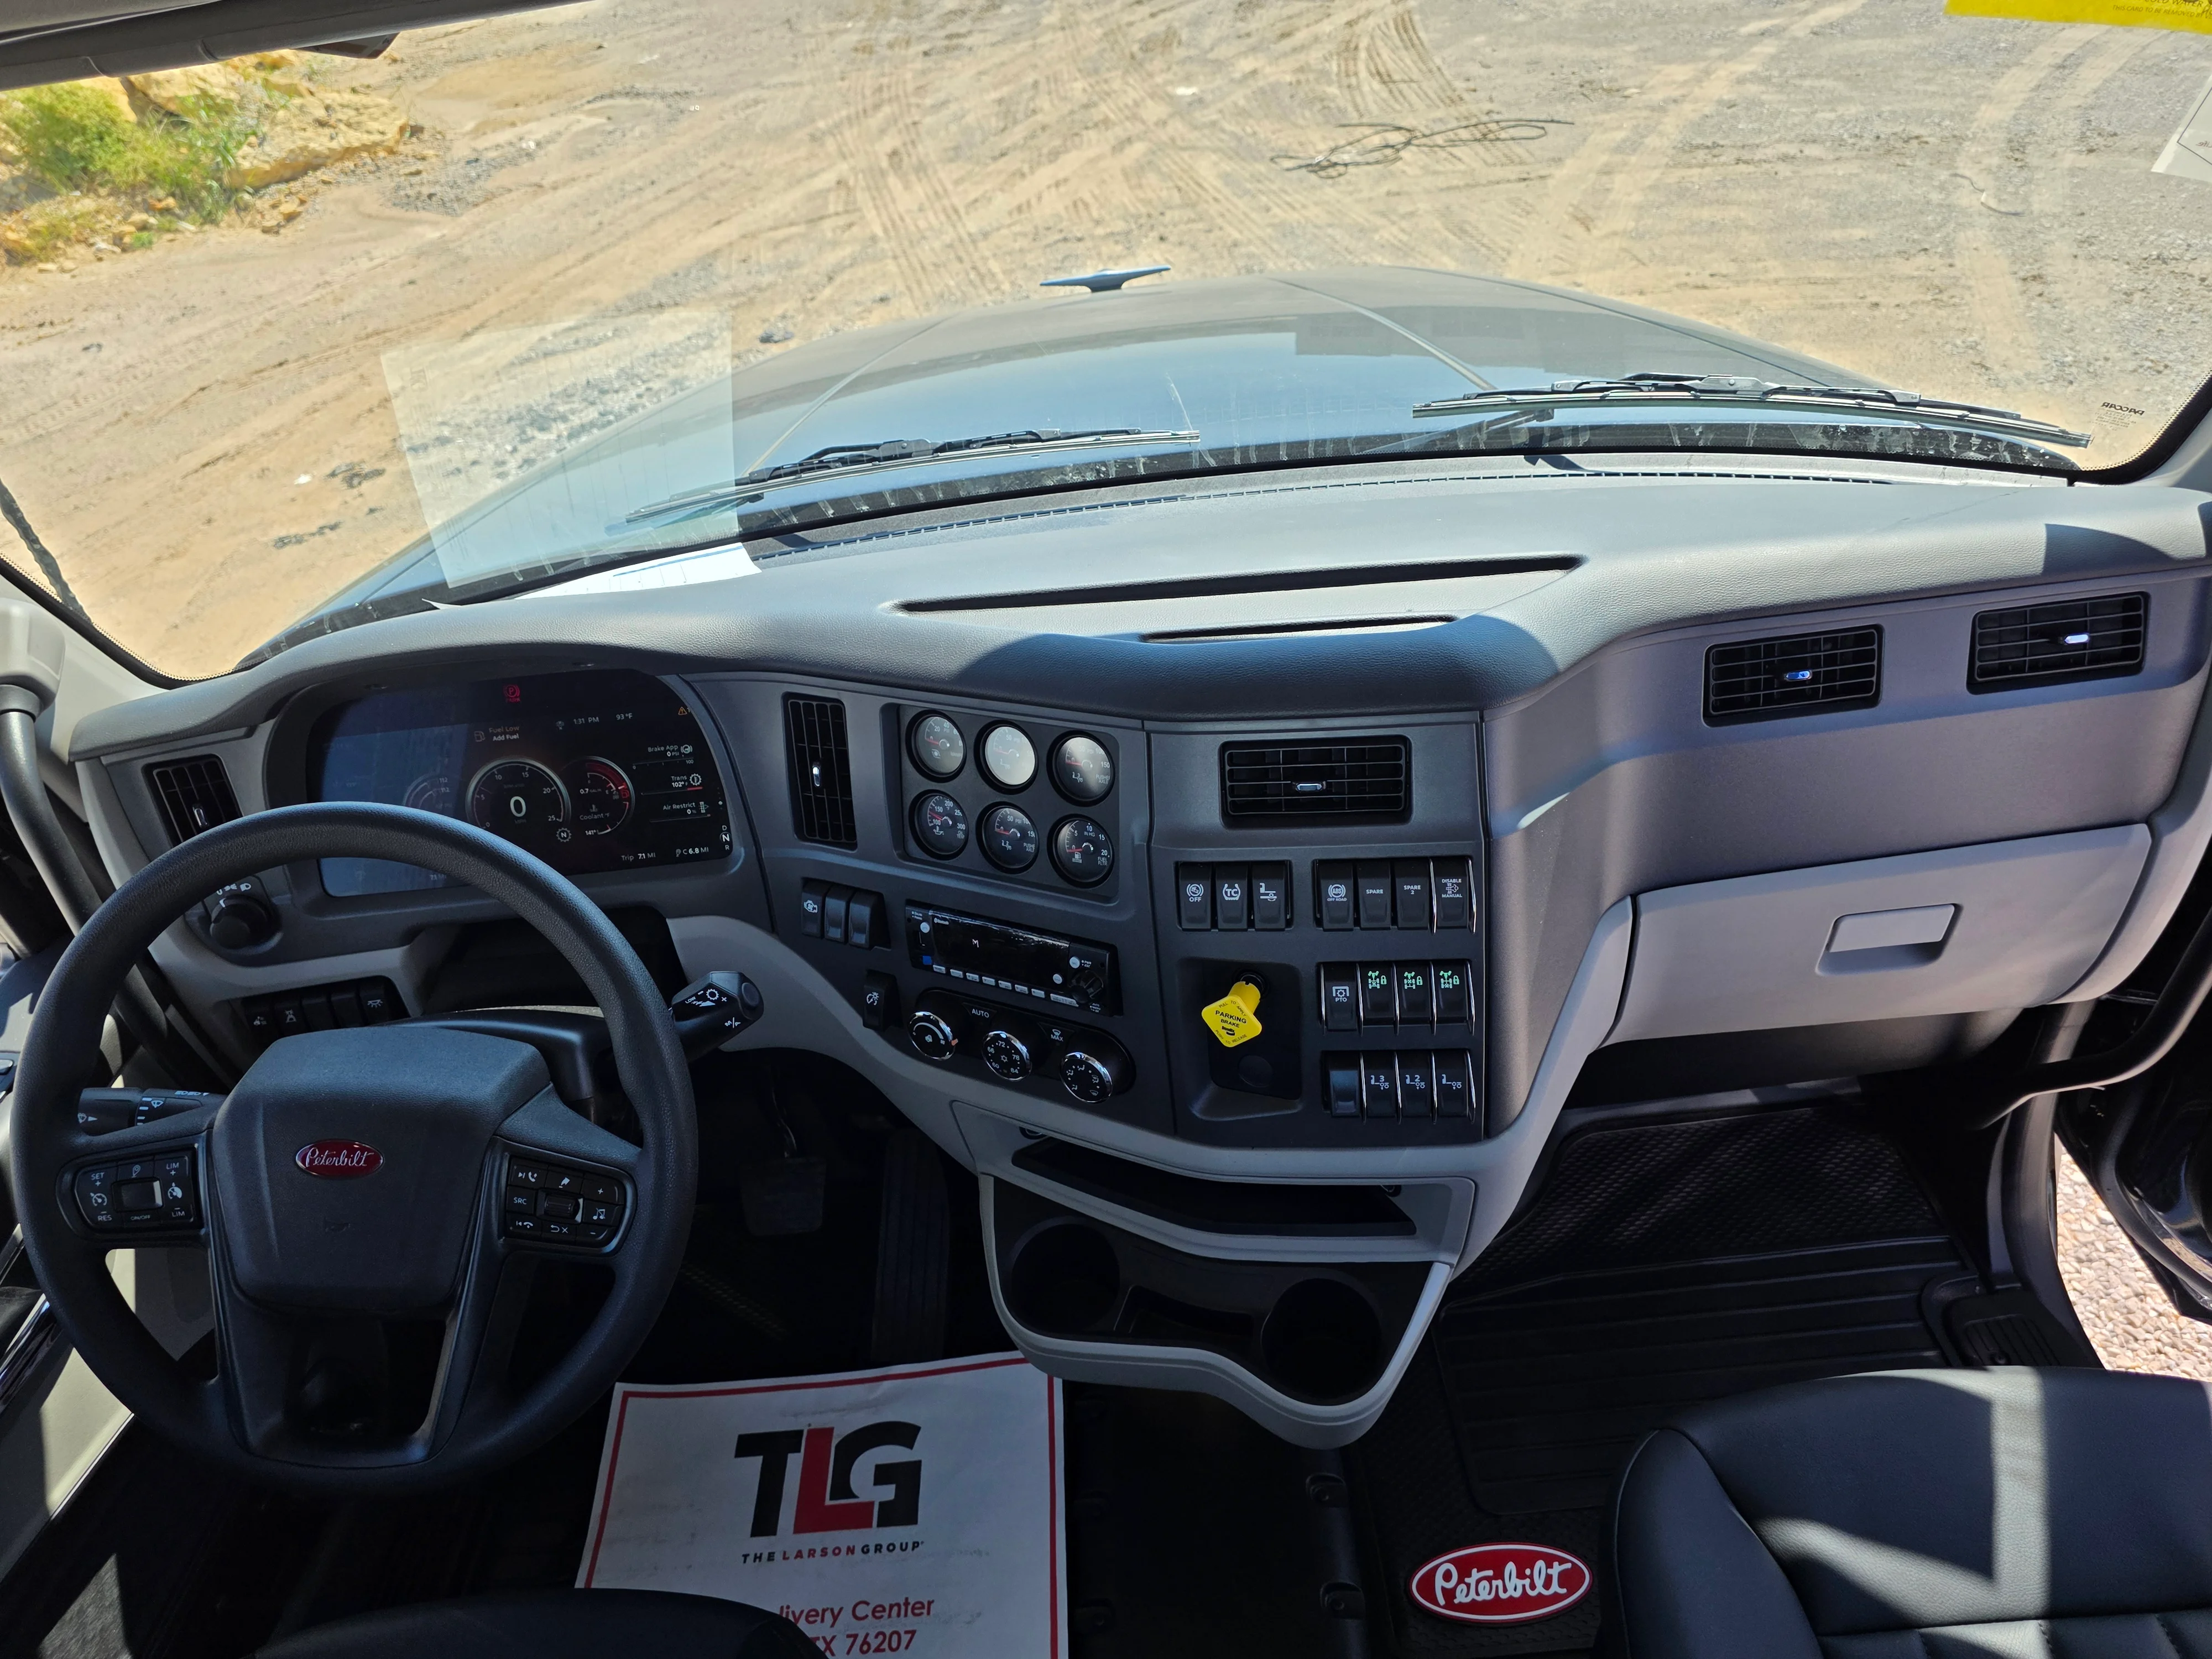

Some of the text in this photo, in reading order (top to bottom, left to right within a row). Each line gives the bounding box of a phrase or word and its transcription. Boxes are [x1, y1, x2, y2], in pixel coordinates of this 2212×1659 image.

[2163, 9, 2195, 17] REMOVED
[510, 796, 526, 817] 0
[972, 1008, 990, 1019] AUTO
[1215, 1010, 1246, 1024] PARKING
[1220, 1019, 1240, 1028] BRAKE
[1051, 1034, 1064, 1042] MAX
[1232, 1034, 1248, 1043] RELEASE
[305, 1150, 369, 1168] Peterbilt
[91, 1172, 105, 1180] SET
[513, 1197, 527, 1205] SRC
[734, 1421, 922, 1537] TLG
[742, 1541, 920, 1564] THE LARSON GROUP
[1434, 1559, 1572, 1606] Peterbilt
[852, 1597, 935, 1621] Center
[846, 1629, 917, 1656] 76207
